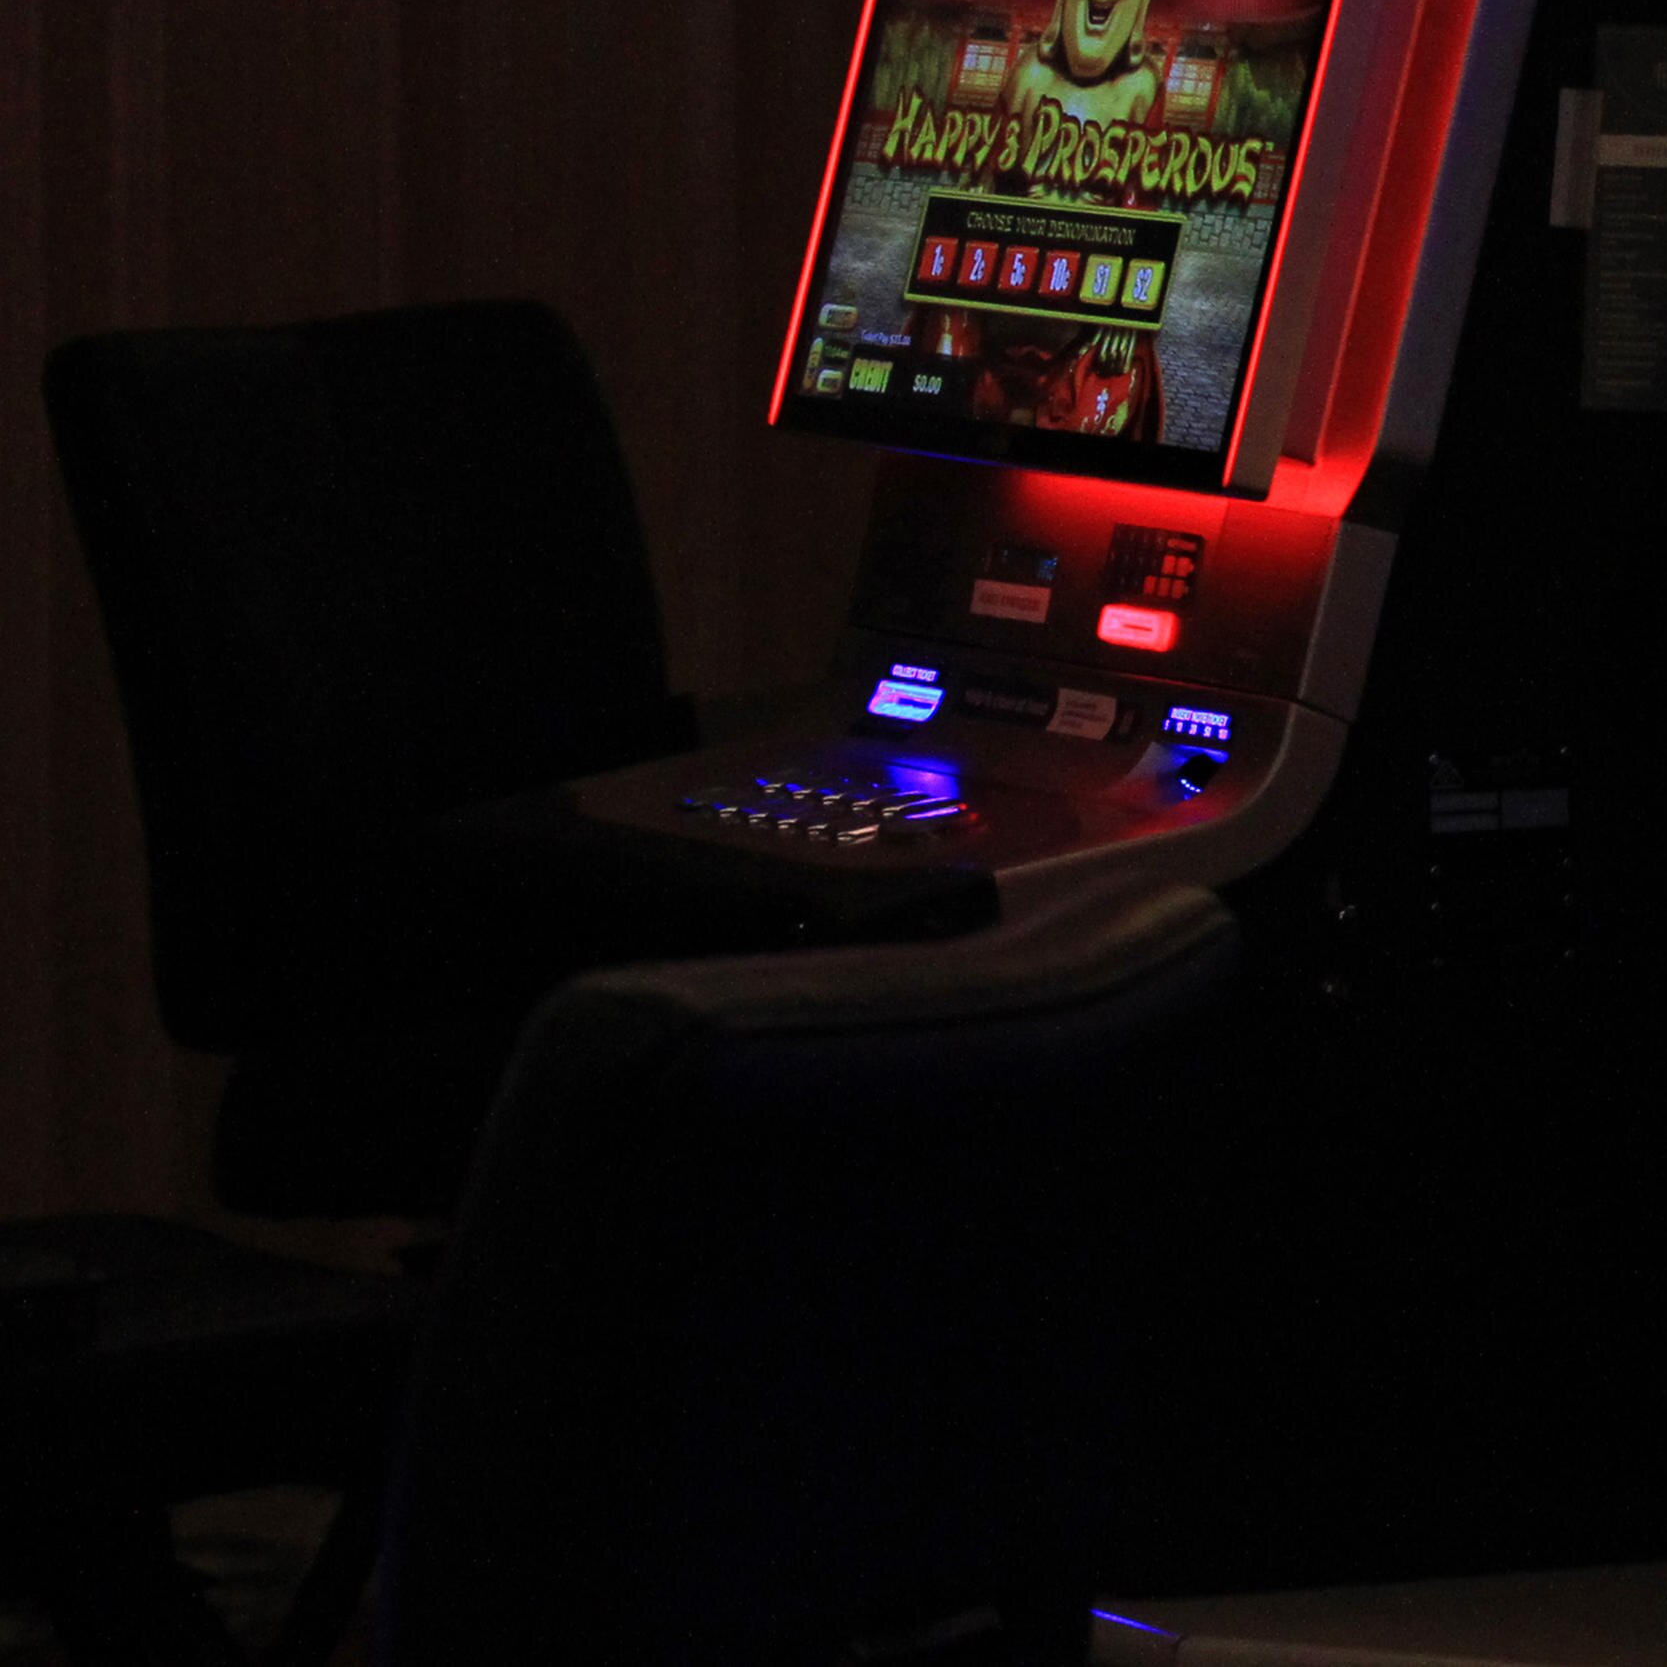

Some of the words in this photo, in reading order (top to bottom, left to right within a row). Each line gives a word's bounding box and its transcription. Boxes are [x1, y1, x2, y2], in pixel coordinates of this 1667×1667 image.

[883, 86, 1003, 171] HAPPY
[1022, 97, 1262, 200] PROSPEROUS
[966, 210, 1014, 232] CHOOSE
[1016, 215, 1046, 238] YOUR
[1048, 219, 1136, 246] DENOMINATION
[1094, 264, 1112, 297] $1
[1132, 266, 1153, 303] $2
[849, 357, 894, 394] CREDIT
[912, 373, 943, 396] $0.00
